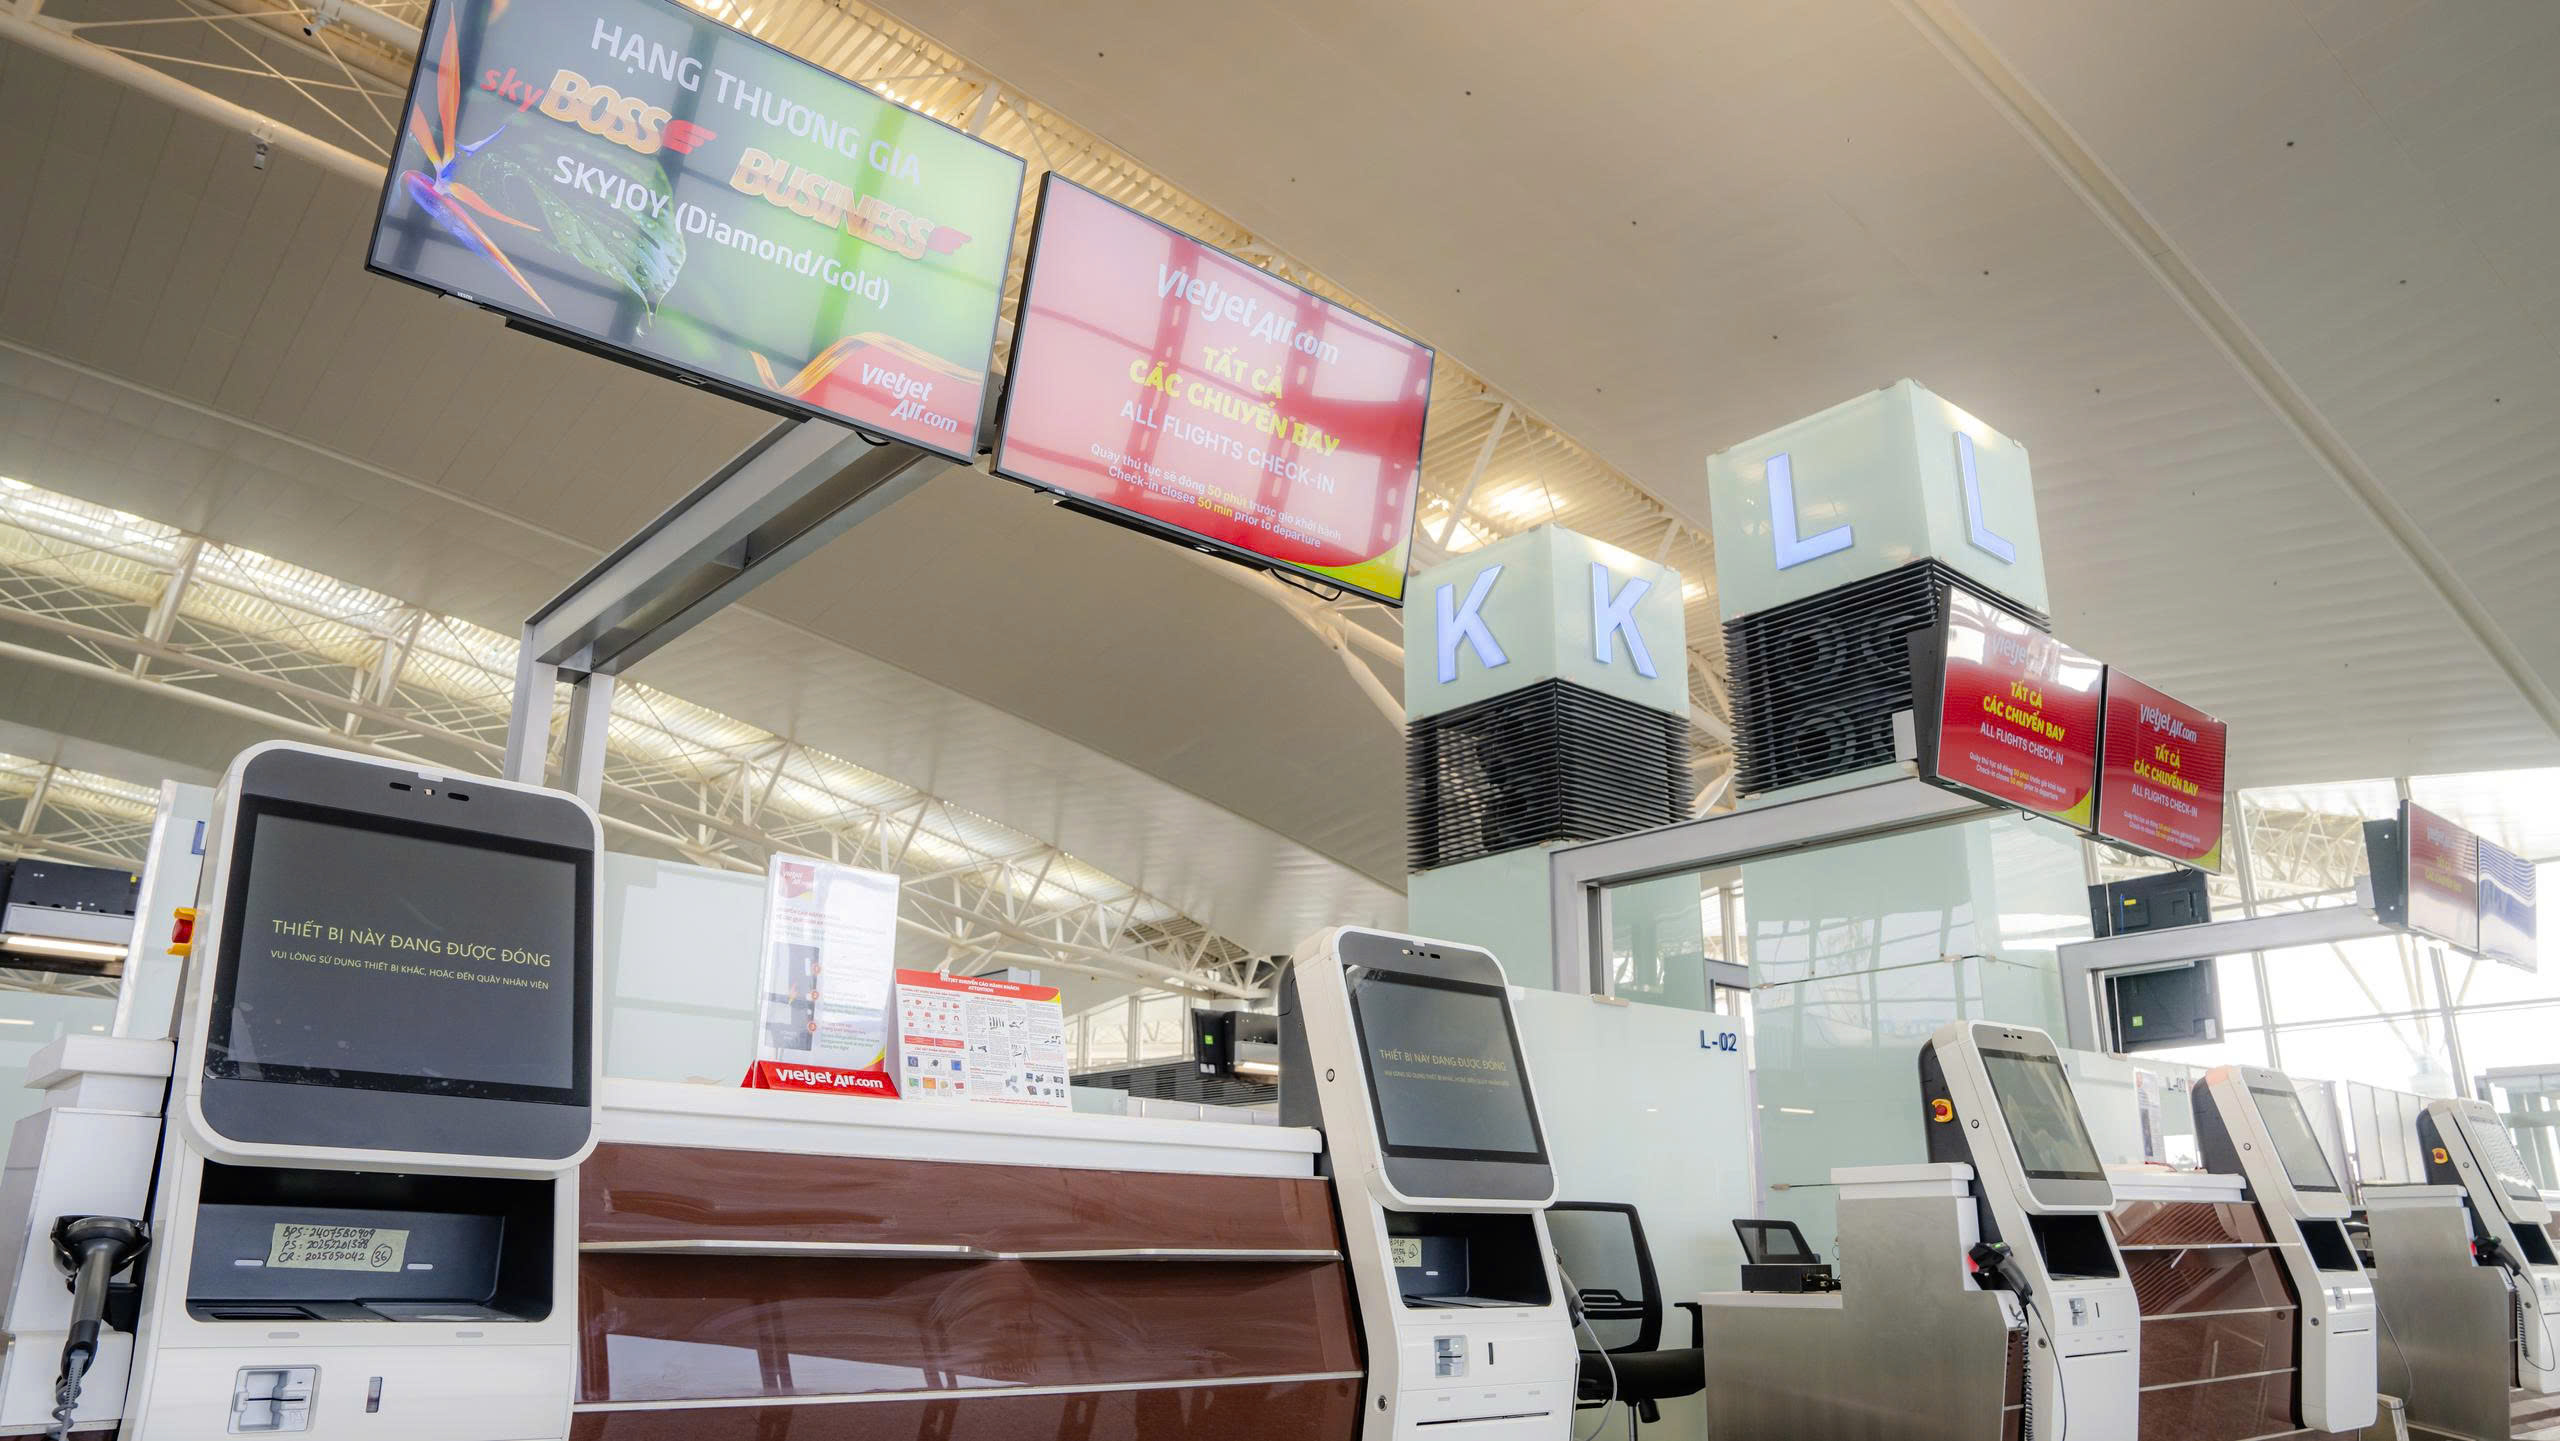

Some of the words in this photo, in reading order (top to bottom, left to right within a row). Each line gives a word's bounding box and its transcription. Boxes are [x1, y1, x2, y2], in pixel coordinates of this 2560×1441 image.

[591, 17, 703, 92] HẠNG
[714, 69, 861, 160] THƯƠNG
[869, 140, 921, 186] GIA
[553, 155, 670, 219] SKYJOY
[675, 202, 891, 310] (Diamond/Gold)
[729, 147, 936, 261] BUSINESS
[1129, 359, 1183, 398] CÁC
[1187, 382, 1289, 440] CHUYẾN
[1291, 421, 1340, 457] BAY
[1203, 345, 1249, 383] TẤT
[1251, 365, 1283, 400] CẢ
[1120, 400, 1158, 429] ALL
[1162, 414, 1245, 461] FLIGHTS
[1247, 447, 1336, 495] CHECK-IN
[1108, 465, 1159, 493] Check-in
[1161, 483, 1196, 505] closes
[1197, 495, 1212, 510] 50
[1213, 502, 1233, 518] min
[1234, 510, 1259, 527] prior
[1261, 518, 1271, 531] to
[1273, 520, 1321, 548] departure
[1765, 452, 1853, 571] L
[1953, 430, 2016, 566] L
[1436, 563, 1510, 684] K
[1591, 561, 1659, 680] K
[1980, 721, 1995, 738] ALL
[1996, 727, 2027, 752] FLIGHTS
[2028, 741, 2064, 765] CHECK-IN
[2046, 721, 2065, 742] BAY
[2131, 783, 2143, 797] ALL
[2144, 787, 2169, 808] FLIGHTS
[2169, 797, 2198, 817] CHECK-IN
[2183, 780, 2199, 797] BAY
[270, 949, 287, 960] VUI
[289, 951, 317, 963] LÒNG
[364, 960, 389, 972] THIẾT
[390, 963, 399, 974] BỊ
[502, 976, 528, 988] NHÂN
[529, 979, 549, 990] VIÊN
[272, 919, 323, 938] THIẾT
[328, 926, 344, 944] BỊ
[349, 927, 386, 947] NÀY
[390, 934, 442, 954] ĐANG
[446, 941, 497, 961] ĐƯỢC
[501, 947, 551, 967] ĐÓNG
[1700, 1030, 1737, 1051] L-02
